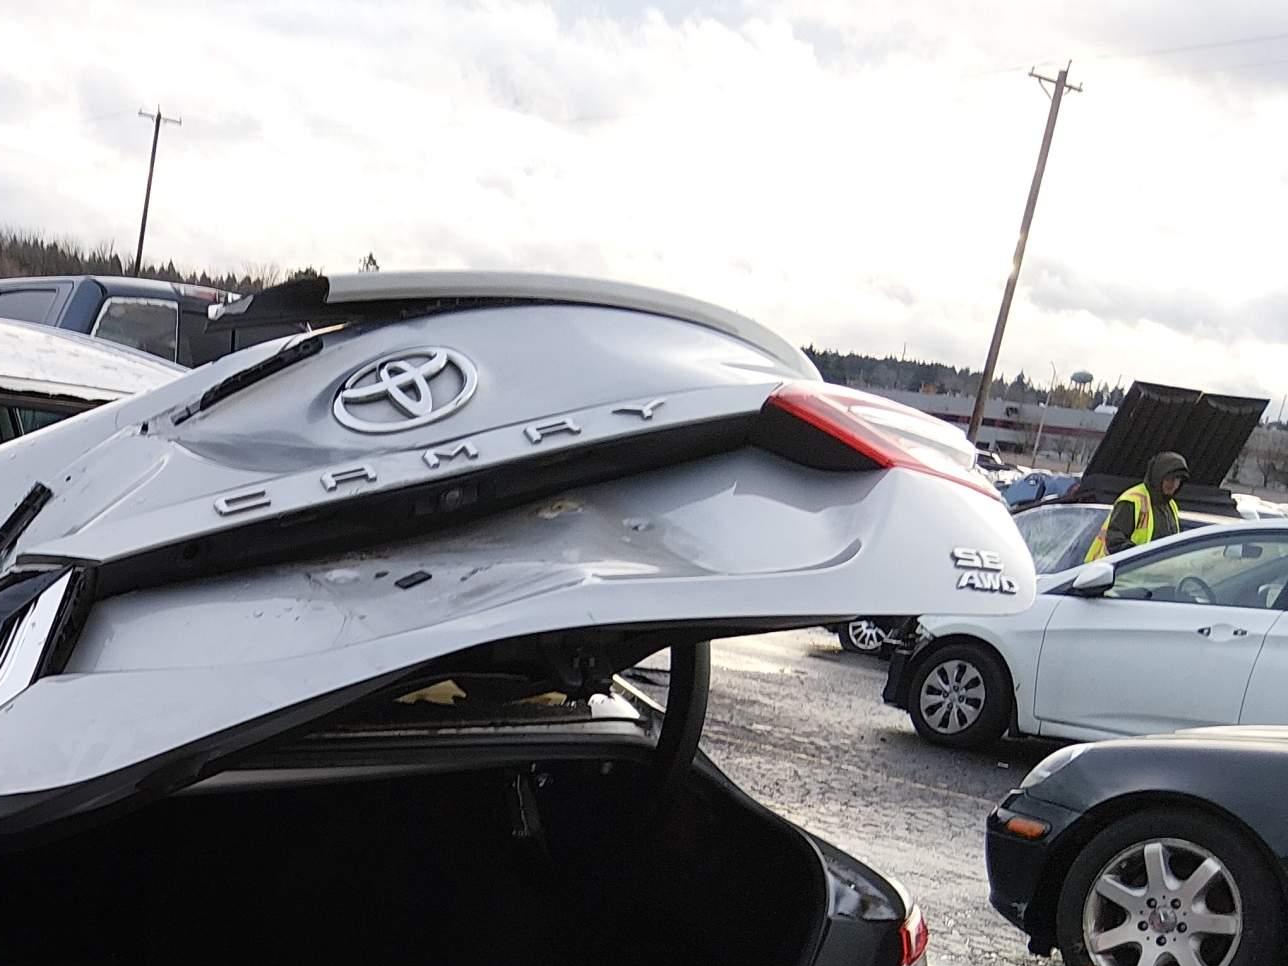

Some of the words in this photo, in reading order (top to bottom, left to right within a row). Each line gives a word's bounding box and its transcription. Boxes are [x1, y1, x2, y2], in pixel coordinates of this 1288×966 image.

[213, 399, 668, 516] CAMRY
[951, 546, 1003, 571] SE
[956, 570, 1019, 595] AWD
